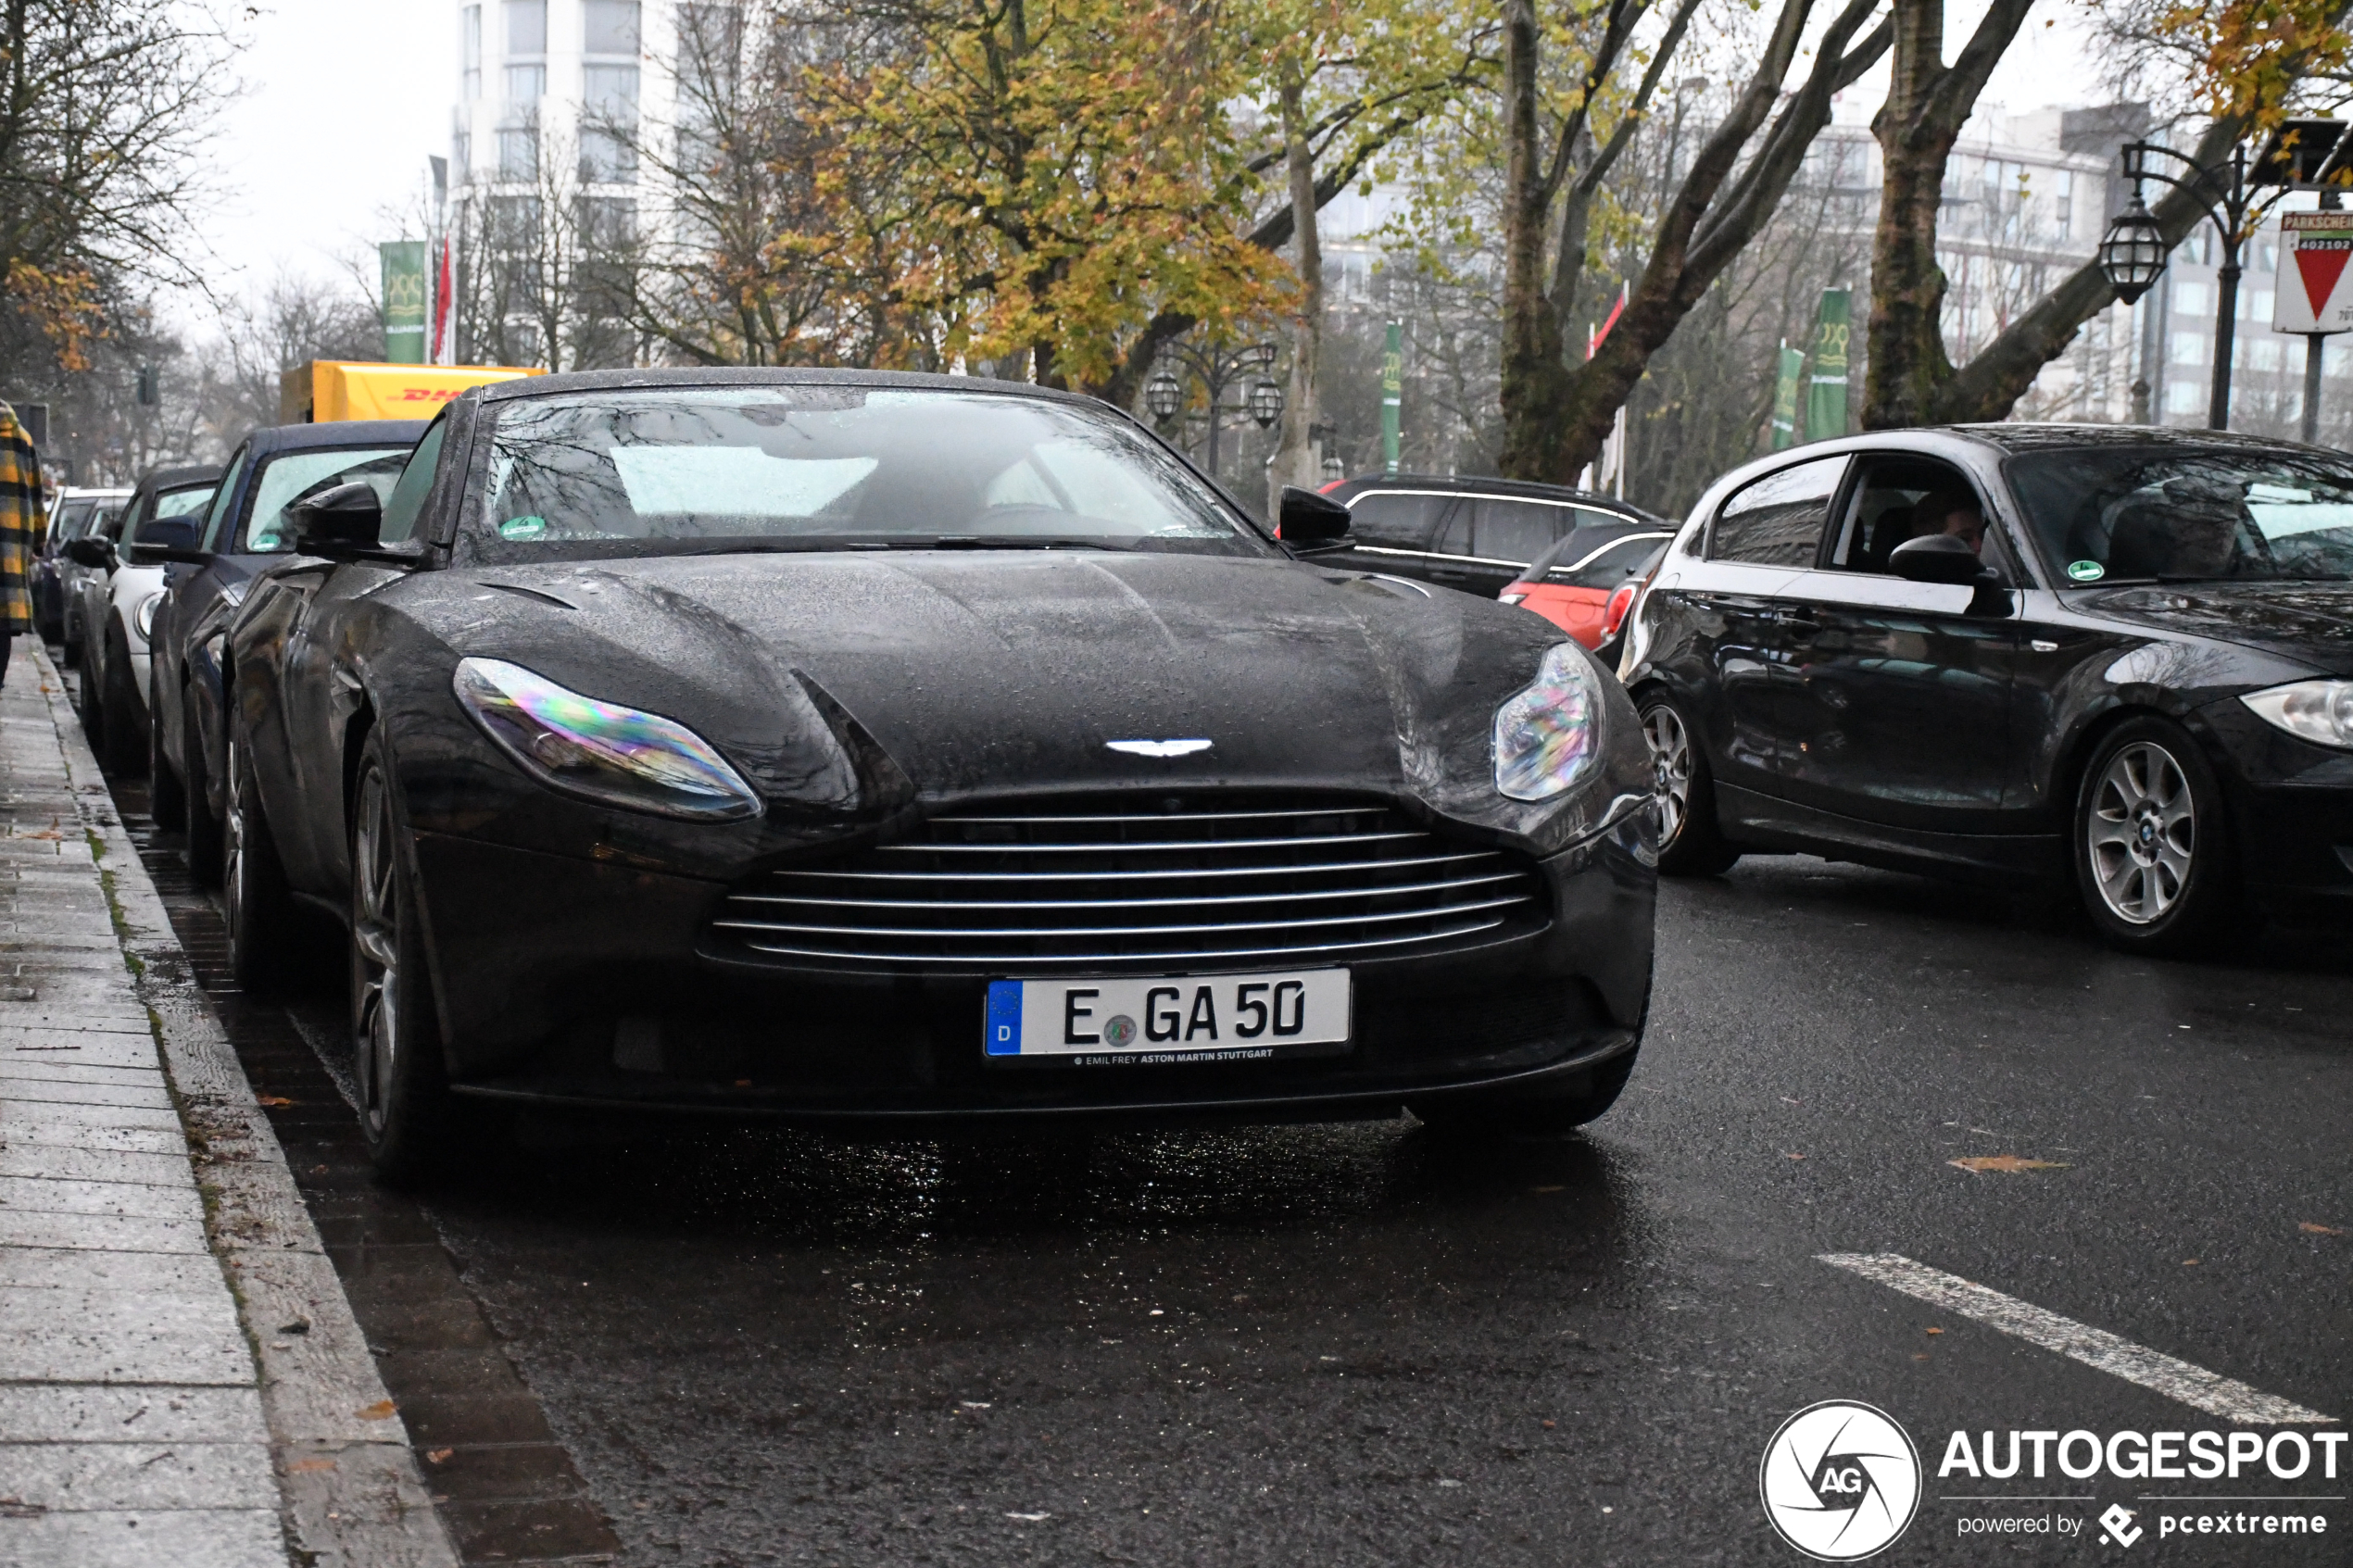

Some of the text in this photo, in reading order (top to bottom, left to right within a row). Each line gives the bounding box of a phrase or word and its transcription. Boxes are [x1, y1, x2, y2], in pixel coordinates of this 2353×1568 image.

[2284, 216, 2353, 230] PARKSCHEI
[2300, 240, 2350, 250] 402102
[403, 388, 463, 402] DH
[1064, 980, 1305, 1045] E GA 50
[998, 1025, 1011, 1041] D
[1086, 1049, 1274, 1065] EMIL FREY ASTON MARTIN STUTTGART
